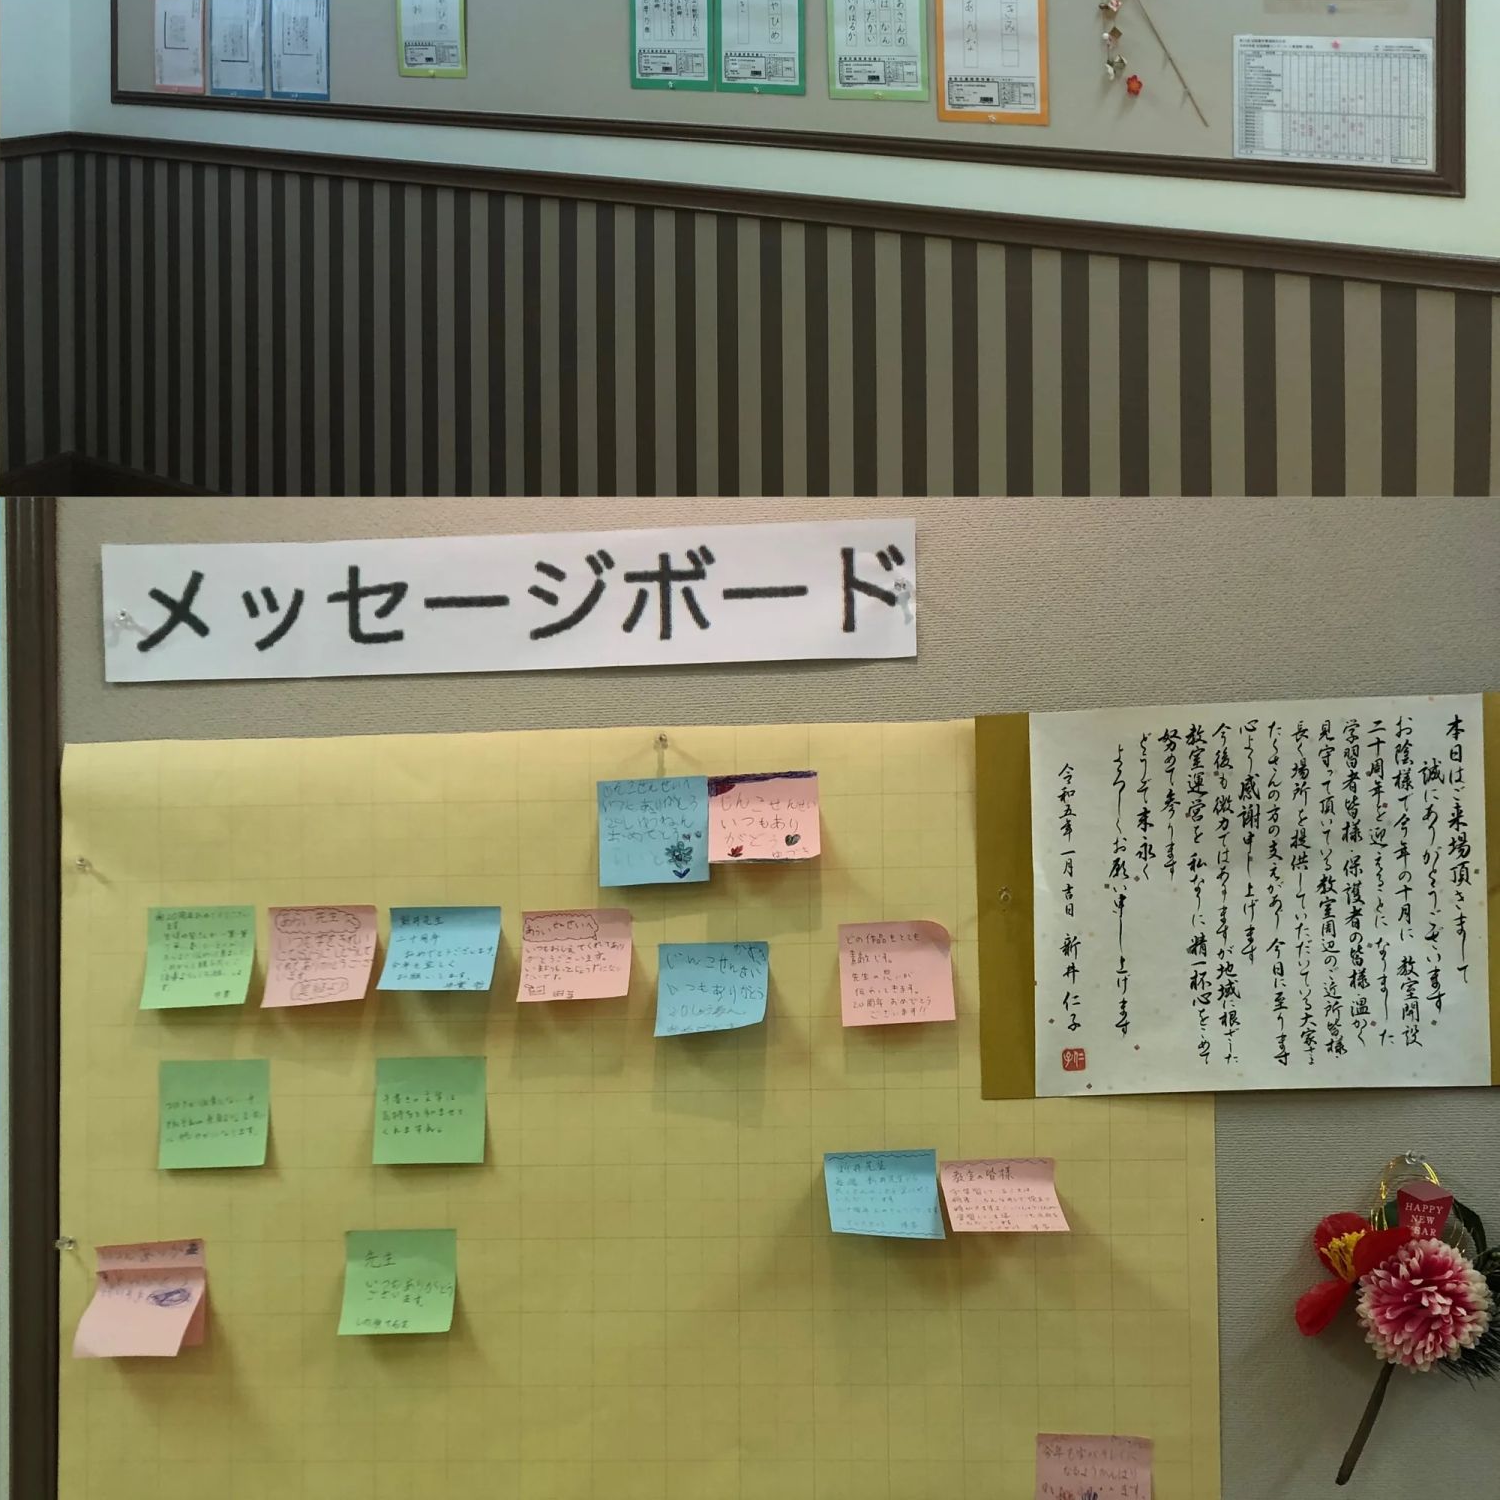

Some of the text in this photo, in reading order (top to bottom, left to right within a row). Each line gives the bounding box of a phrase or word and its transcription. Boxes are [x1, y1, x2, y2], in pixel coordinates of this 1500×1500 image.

[137, 545, 905, 653] メッセージボード
[1405, 1202, 1443, 1214] HAPPY
[1411, 1215, 1435, 1224] NEW
[1411, 1226, 1436, 1236] EAR
